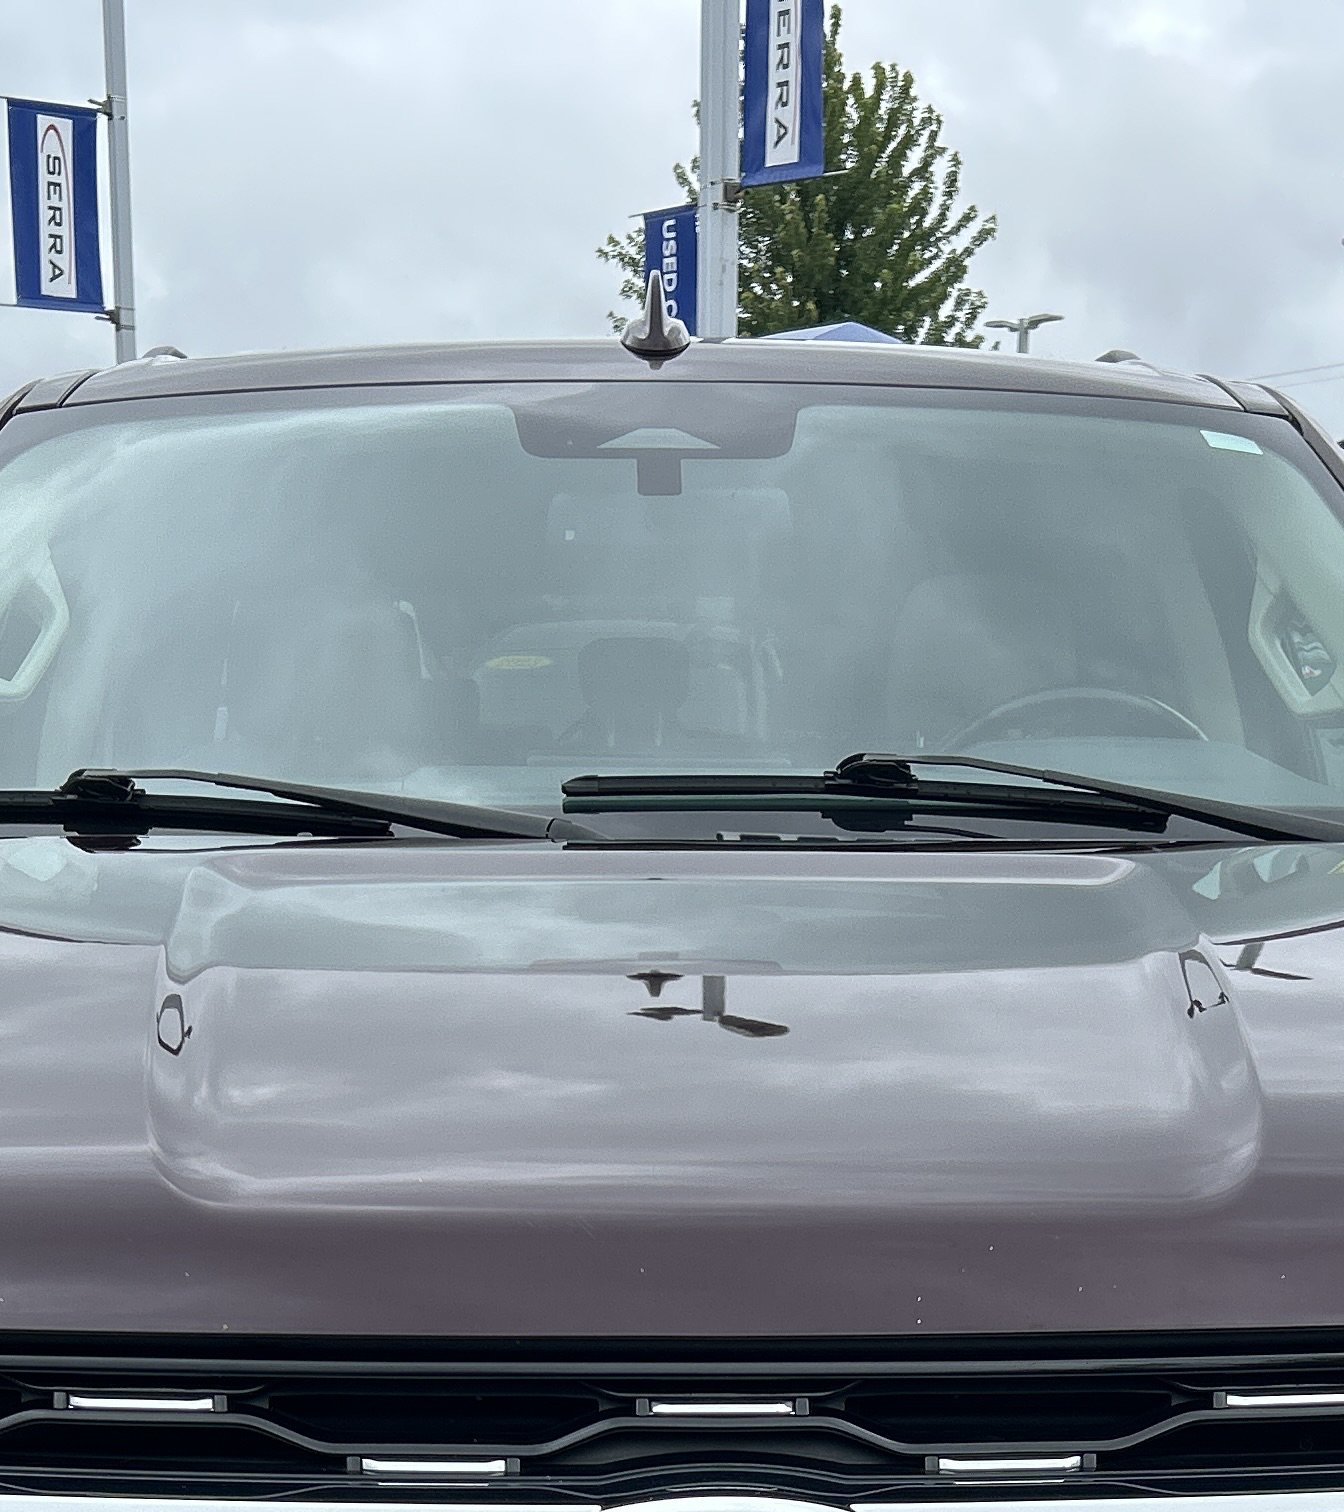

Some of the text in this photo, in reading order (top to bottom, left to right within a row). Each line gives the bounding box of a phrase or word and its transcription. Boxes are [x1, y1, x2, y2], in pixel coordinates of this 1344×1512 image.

[773, 0, 791, 149] ERRA
[46, 153, 64, 283] SERRA
[662, 219, 678, 292] USED
